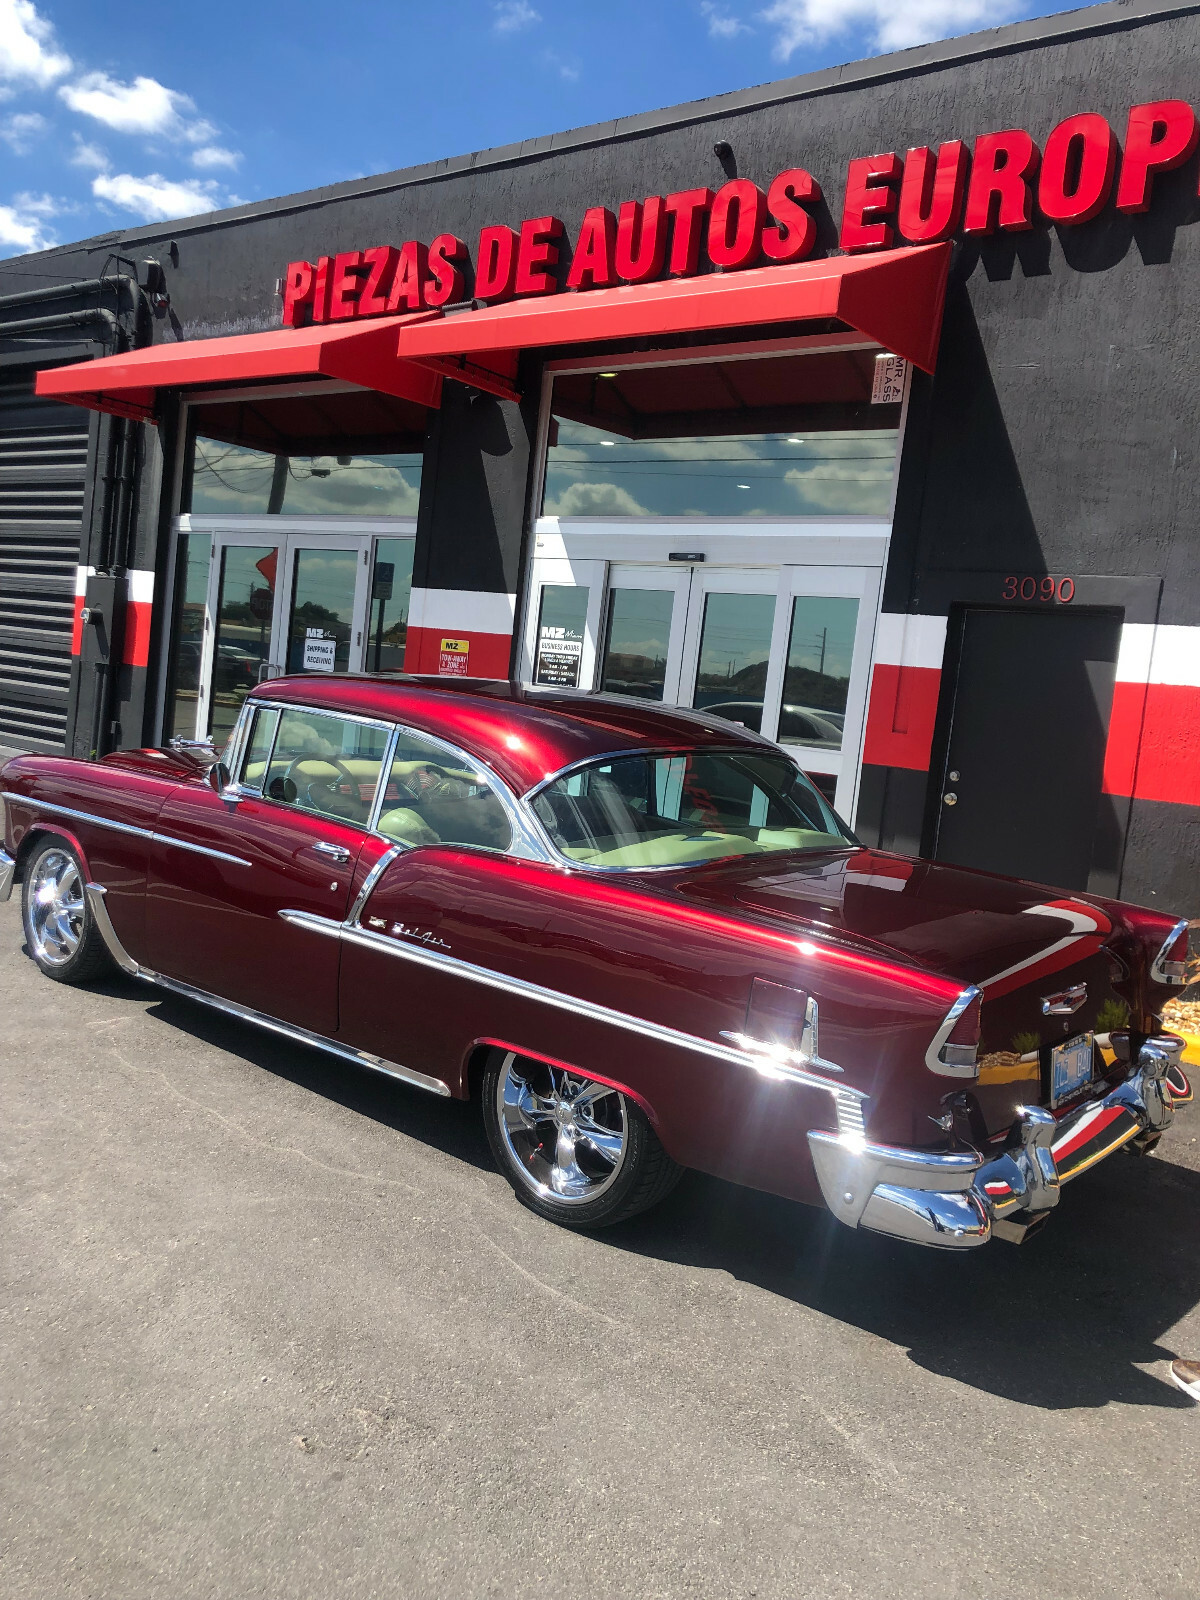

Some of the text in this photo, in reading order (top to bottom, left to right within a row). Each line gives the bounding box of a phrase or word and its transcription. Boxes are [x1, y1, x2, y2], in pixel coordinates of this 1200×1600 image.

[282, 99, 1200, 328] PIEZAS DE AUTOS EUROP
[882, 357, 895, 402] GLASS
[1002, 576, 1075, 603] 3090
[306, 628, 324, 639] MZ
[541, 627, 565, 639] MZ
[306, 644, 329, 654] SHIPPING
[446, 642, 458, 650] MZ
[541, 642, 580, 652] BUSINESS HOURS
[306, 655, 332, 665] RECEIVING
